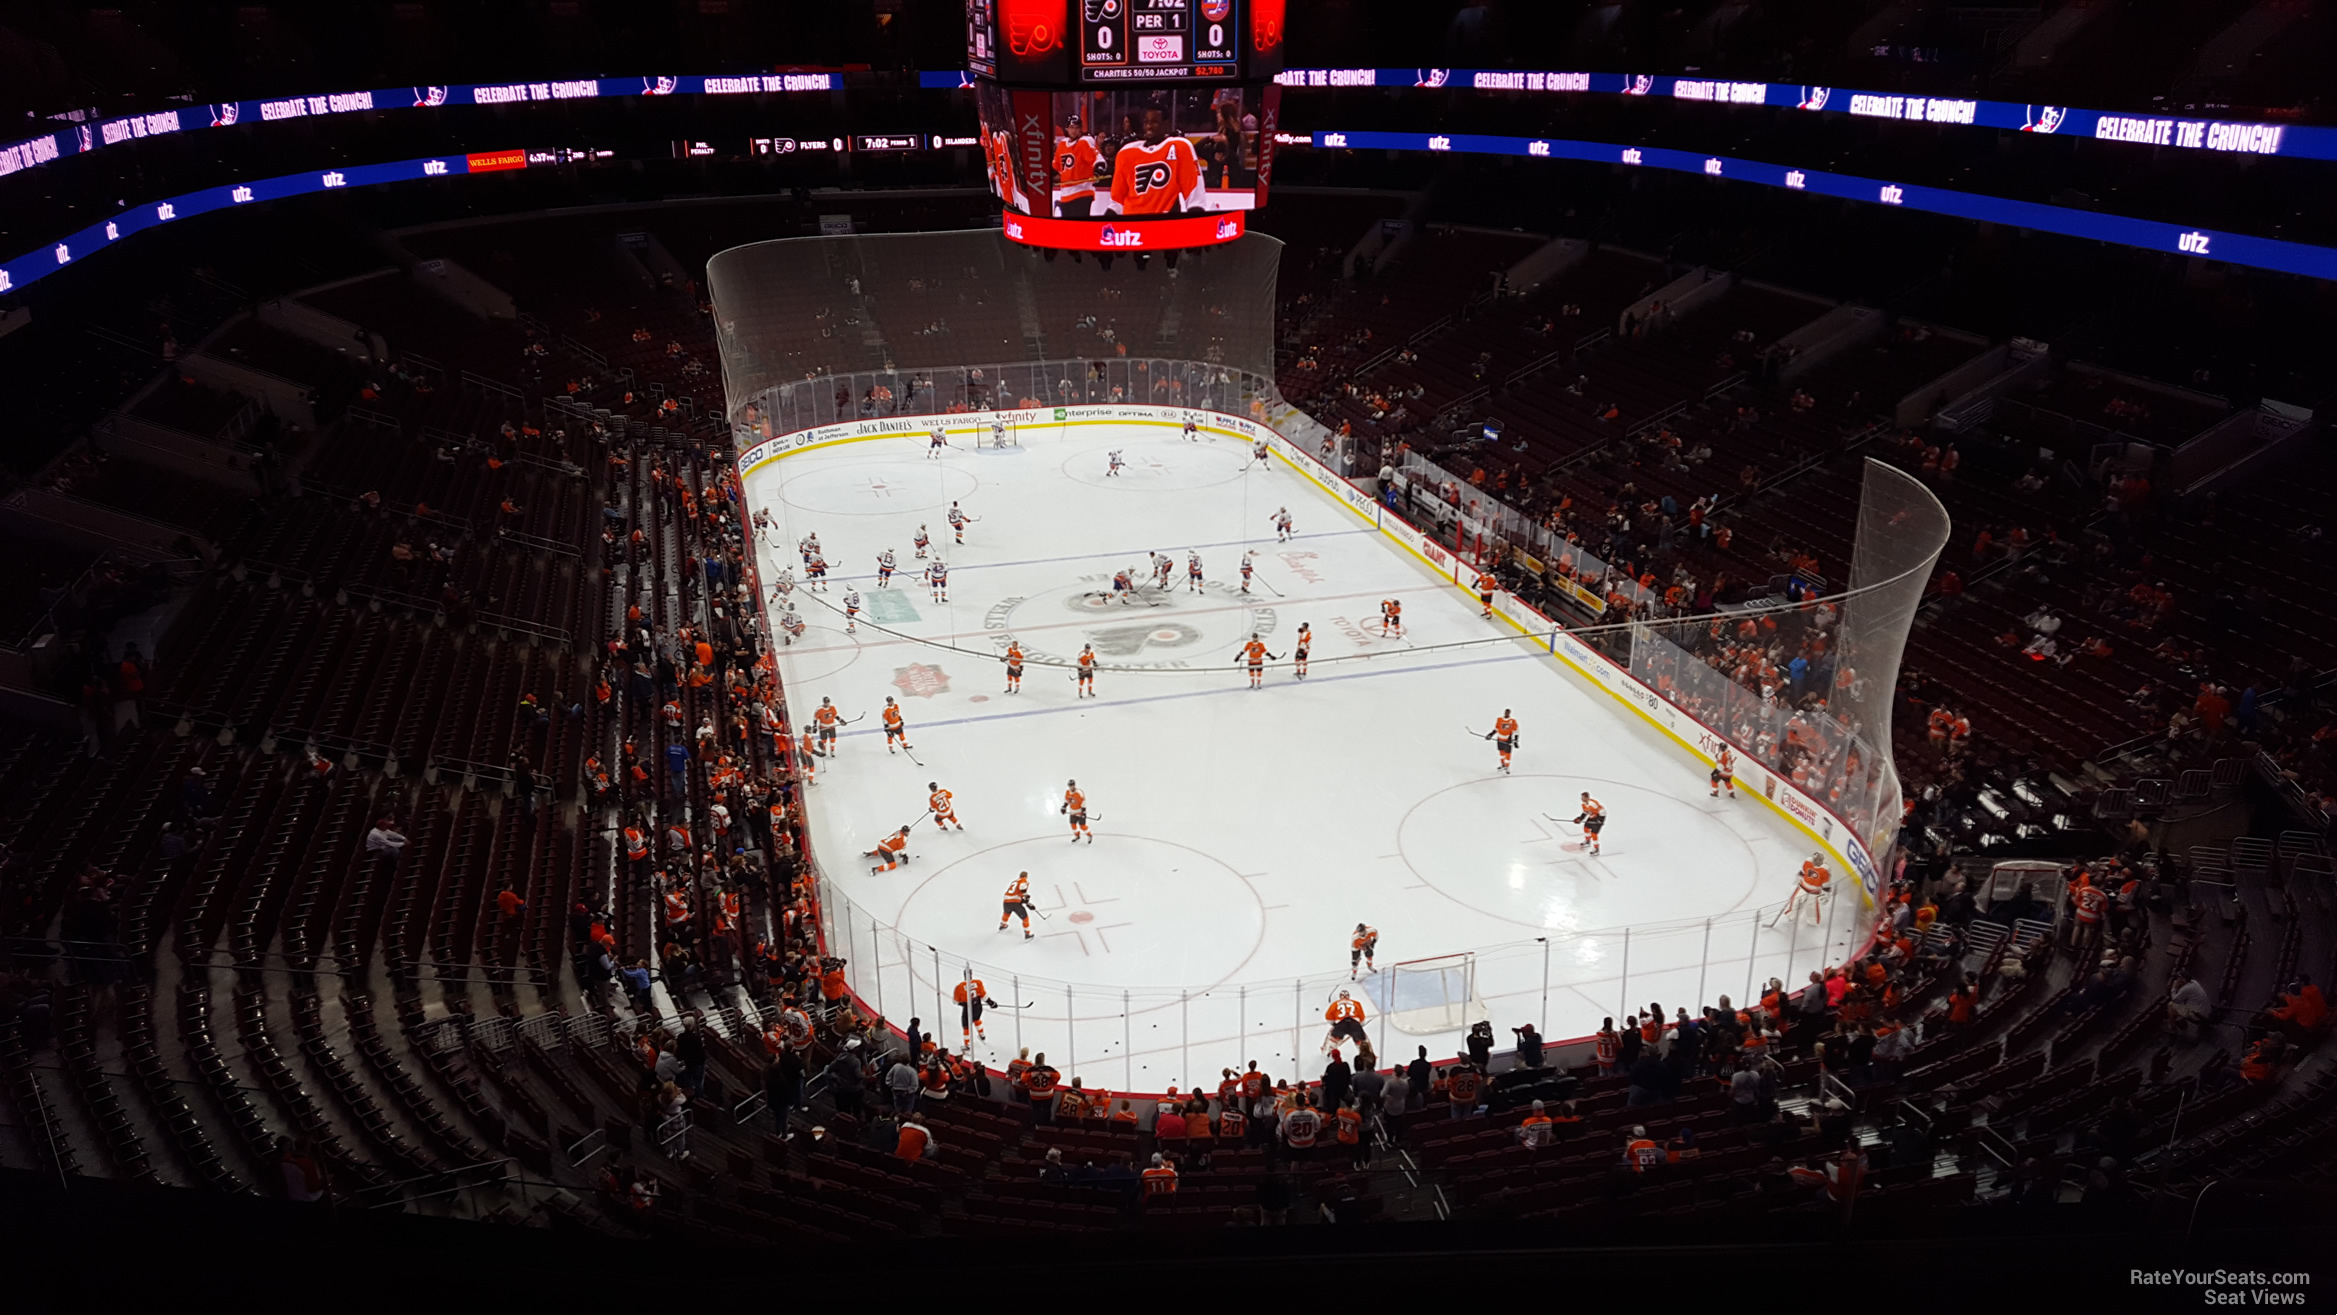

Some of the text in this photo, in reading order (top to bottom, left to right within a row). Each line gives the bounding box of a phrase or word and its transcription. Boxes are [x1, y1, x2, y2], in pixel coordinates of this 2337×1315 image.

[1136, 13, 1180, 28] PER 1
[1098, 26, 1112, 49] 0
[1209, 24, 1223, 47] 0
[1086, 53, 1113, 61] SHOTS:
[1142, 51, 1178, 60] TOYOTA
[1197, 50, 1231, 59] SHOTS: 0
[1094, 66, 1223, 78] CHARITIES 50/50 JACKPOT $2,780
[1308, 70, 1328, 86] THE
[1330, 69, 1376, 86] CRUNCH!
[704, 74, 830, 94] CELEBRATE THE CRUNCH!
[1474, 73, 1590, 91] CELEBRATE THE CRUNCH!
[474, 80, 599, 104] CELEBRATE THE CRUNCH!
[1674, 80, 1767, 104] CELEBRATE THE CRUNCH!
[261, 92, 374, 121] CELEBRATE THE CRUNCH!
[1851, 95, 1976, 124] CELEBRATE THE CRUNCH!
[865, 137, 889, 149] 7:02
[908, 137, 916, 148] 1
[933, 135, 977, 149] 0 ISLANDERS
[1325, 132, 1348, 148] utz
[1429, 135, 1452, 151] utz
[2096, 116, 2283, 154] CELEBRATE THE CRUNCH!
[761, 144, 768, 154] 0
[800, 137, 843, 151] FLYERS 0
[1257, 107, 1275, 187] xfinity
[1529, 139, 1551, 157] utz
[469, 155, 524, 168] WELLS FARGO
[529, 152, 547, 163] 4:37
[1021, 113, 1047, 196] xfinity
[1623, 147, 1643, 165] utz
[424, 159, 449, 175] utz
[1705, 158, 1723, 176] utz
[323, 171, 347, 188] utz
[1786, 171, 1806, 189] utz
[232, 185, 254, 203] utz
[1880, 184, 1904, 205] utz
[158, 202, 176, 221] utz
[1009, 221, 1024, 240] utz
[1114, 229, 1143, 247] utz
[1223, 221, 1238, 239] utz
[2178, 231, 2210, 255] utz
[952, 417, 981, 425] FARGO
[1001, 412, 1037, 424] xfinity
[1054, 407, 1113, 421] enterprise
[856, 419, 912, 434] JACK DANIEL'S
[826, 431, 849, 440] Jefferson
[739, 447, 763, 472] GEICO
[883, 554, 893, 564] 13
[932, 565, 944, 574] 42
[786, 616, 794, 625] 41
[1329, 616, 1372, 646] TOYOTA
[1564, 641, 1611, 680] Walmart com
[1648, 694, 1659, 710] 80
[936, 796, 950, 810] 21
[1789, 795, 1818, 818] DUNKIN'
[1789, 803, 1816, 826] DONUTS
[1847, 838, 1880, 894] GEICO
[1008, 881, 1018, 894] 3
[1336, 1003, 1355, 1017] 37
[1601, 1043, 1612, 1056] 11
[1033, 1076, 1048, 1088] 28
[1458, 1080, 1473, 1092] 28
[1061, 1101, 1078, 1116] 28
[1222, 1120, 1240, 1135] 20
[1291, 1122, 1311, 1137] 20
